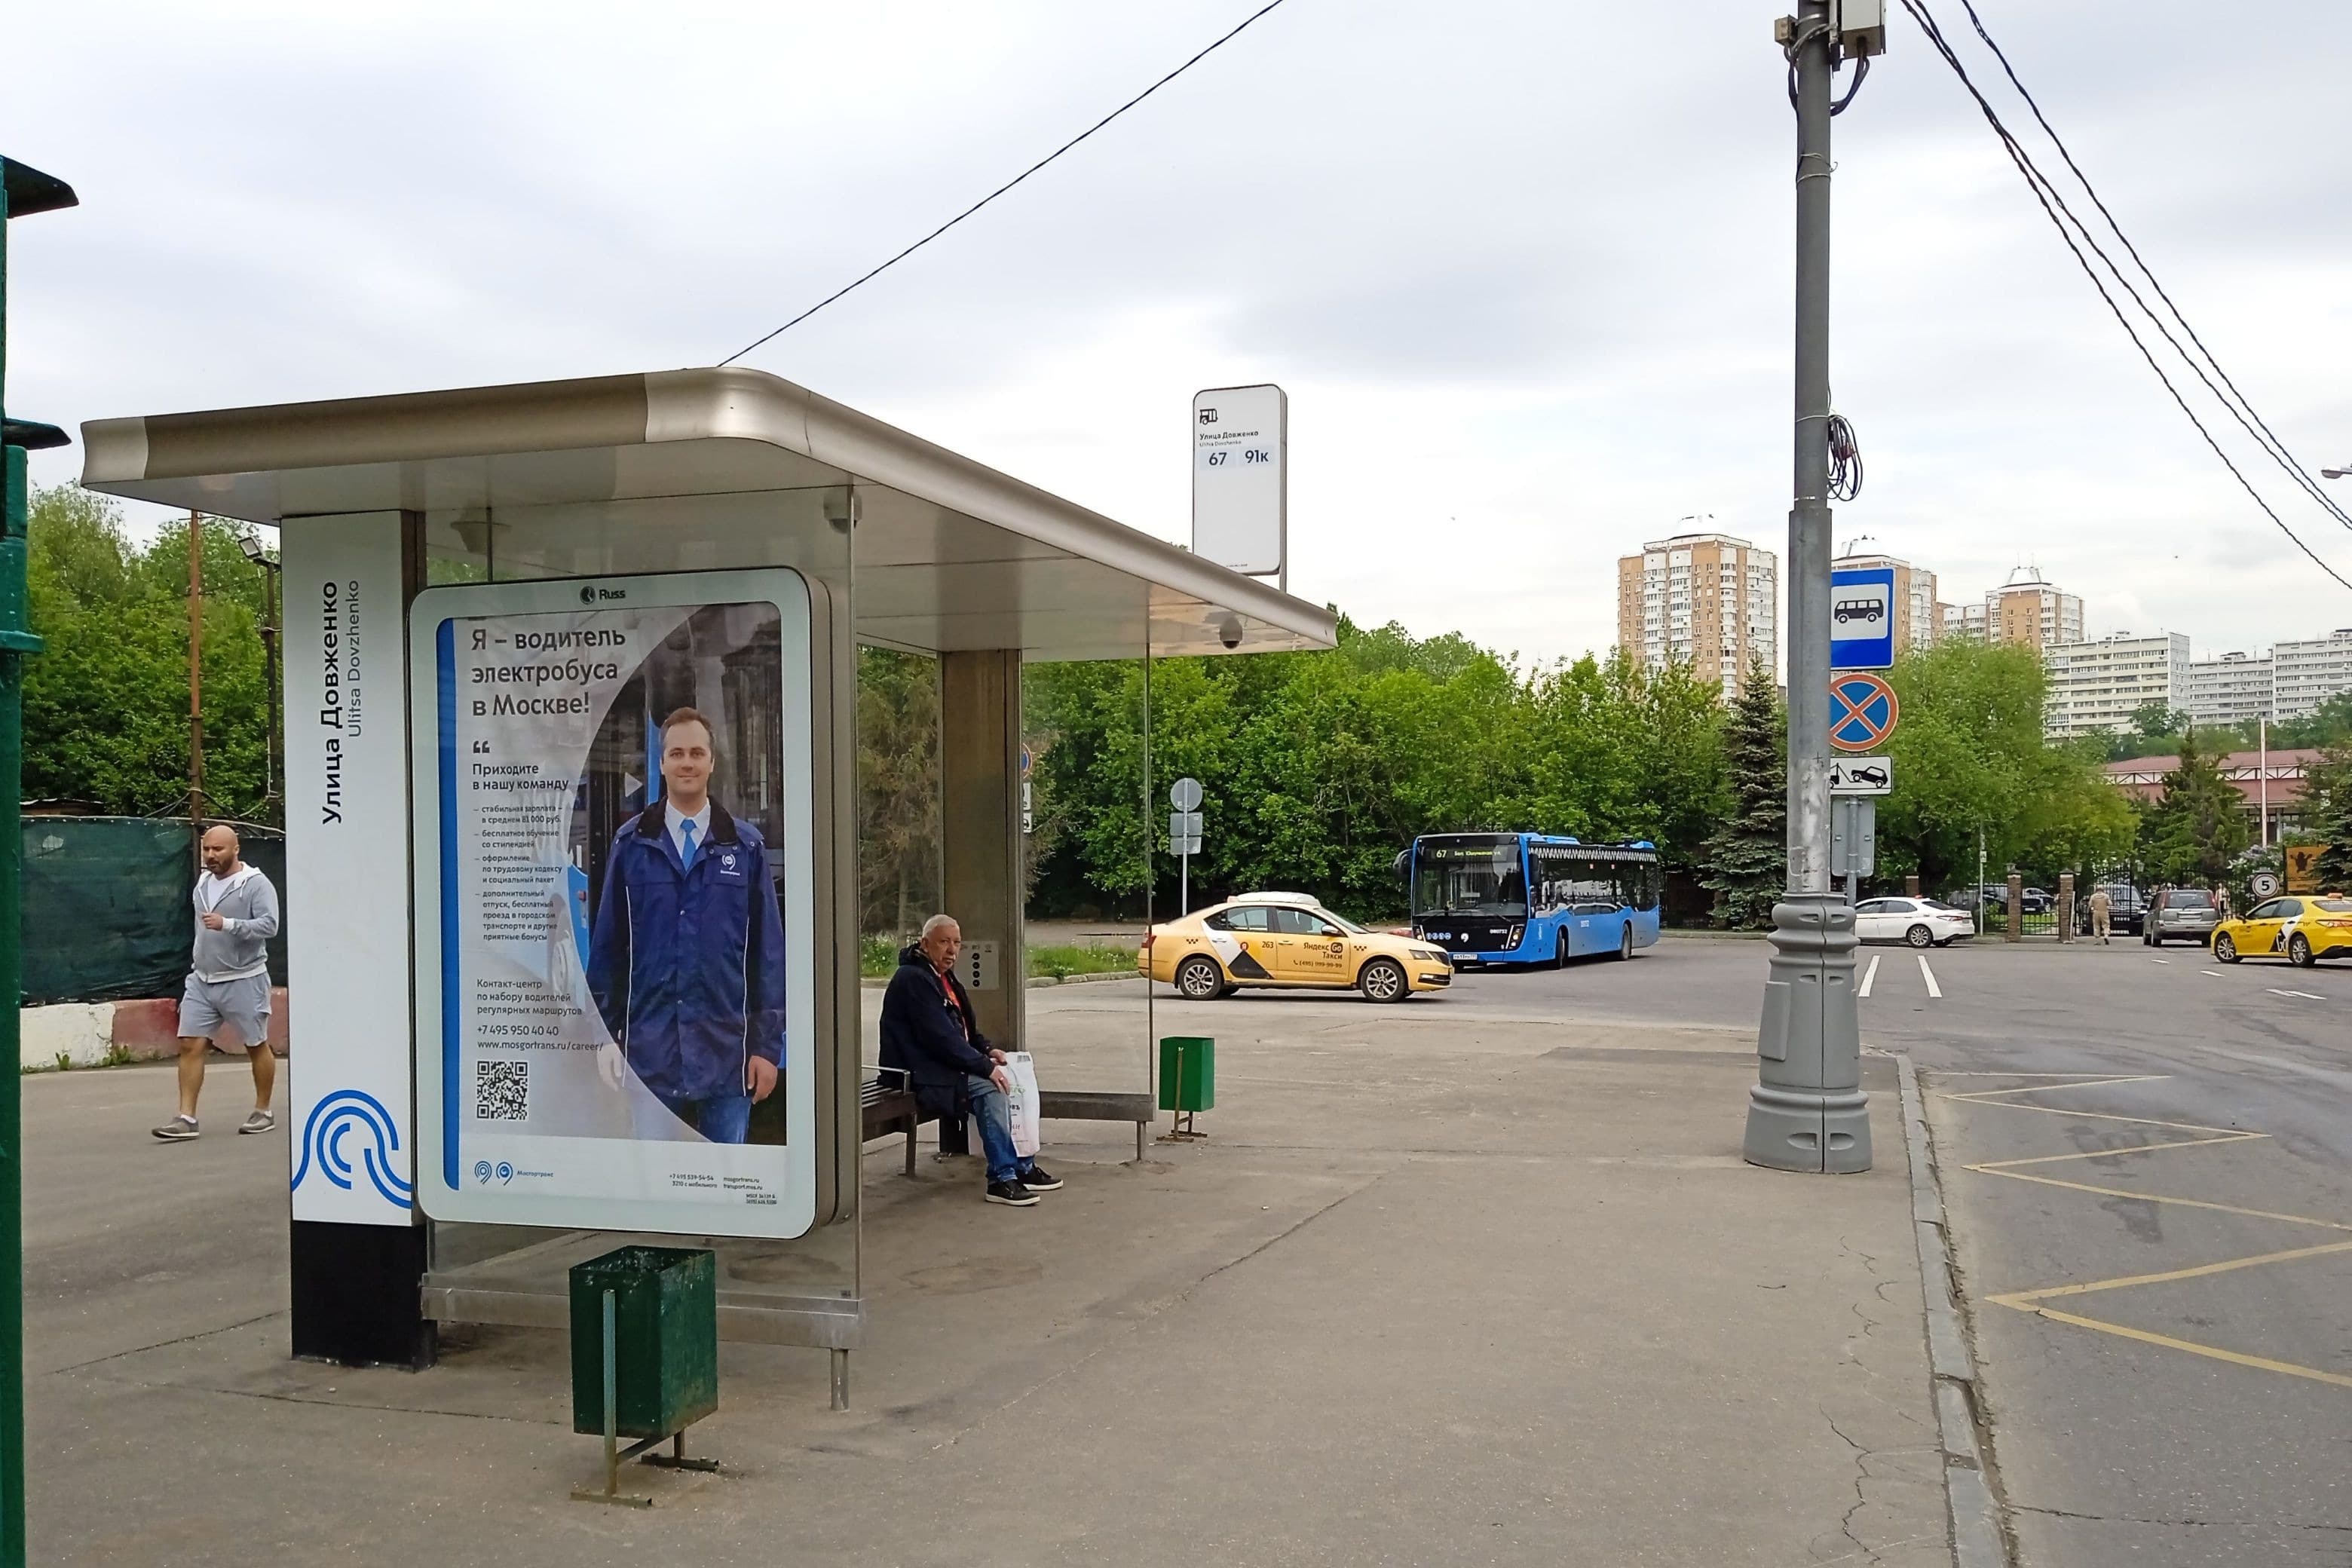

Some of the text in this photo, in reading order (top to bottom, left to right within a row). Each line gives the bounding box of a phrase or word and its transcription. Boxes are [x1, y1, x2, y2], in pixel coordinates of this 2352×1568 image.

[1222, 431, 1259, 439] Довженко
[1208, 452, 1227, 466] 67
[599, 589, 626, 600] Russ
[471, 629, 486, 651] Я
[515, 629, 626, 651] водитель
[345, 580, 362, 737] Ulitsa Dovzhenko
[471, 658, 618, 686] электробуса
[320, 581, 343, 825] Улица Довженко
[473, 691, 590, 716] в Москве!
[473, 764, 539, 777] Приходите
[473, 779, 569, 792] в нашу команду
[482, 804, 523, 813] стабильная
[525, 805, 556, 813] зарплата
[526, 830, 559, 838] обучение
[492, 841, 535, 849] стипендией
[482, 855, 530, 863] оформление
[1436, 849, 1447, 859] 67
[534, 866, 562, 874] кодексу
[488, 876, 534, 884] социальный
[2261, 880, 2270, 891] 5
[512, 900, 553, 908] бесплатный
[521, 933, 547, 942] бонусы
[1303, 942, 1343, 952] Яндекс Go
[1322, 951, 1343, 960] Такси
[477, 979, 542, 990] Контакт-центр
[489, 991, 523, 1003] набору
[525, 993, 571, 1003] водителей
[477, 1006, 582, 1017] регулярных маршрутов
[477, 1024, 559, 1036] +7 495 950 40 40
[477, 1040, 604, 1052] www.mosgortrans.ru/career/
[516, 1170, 554, 1178] Мосгортранс
